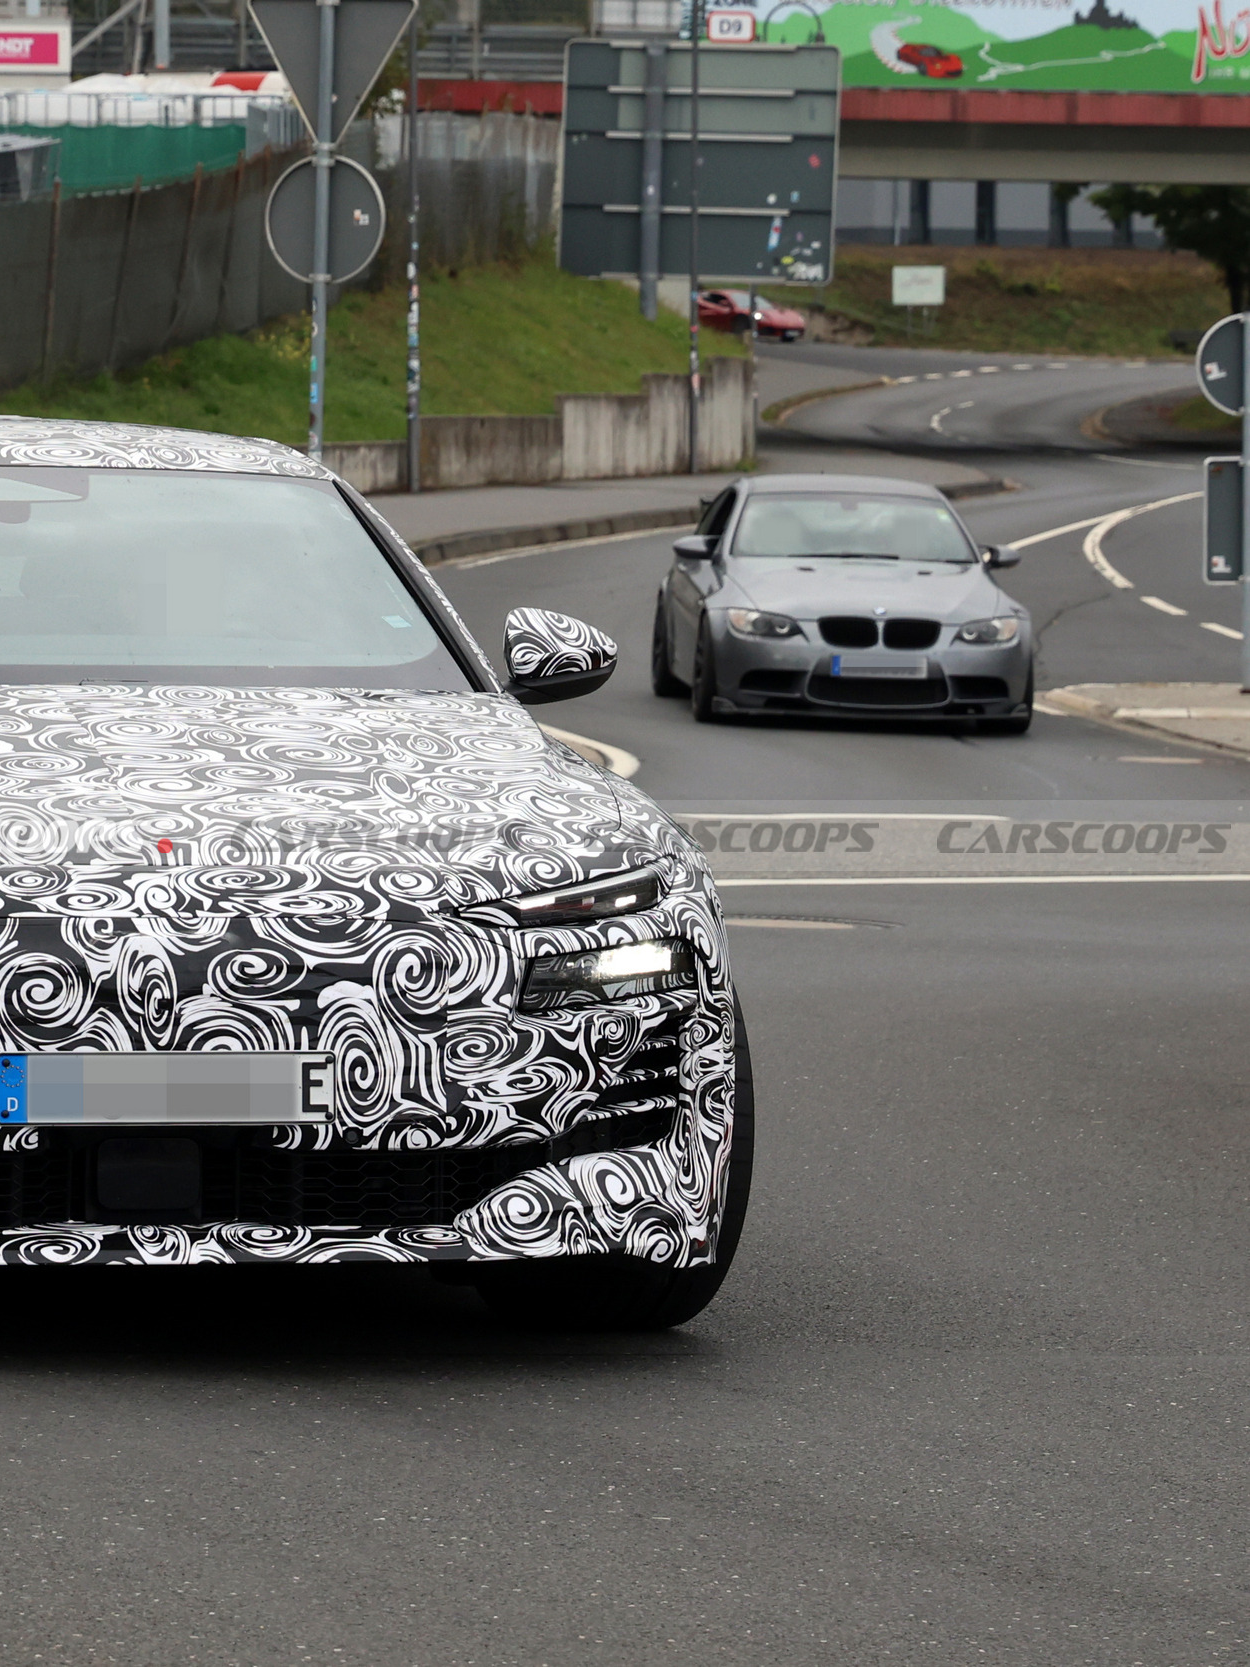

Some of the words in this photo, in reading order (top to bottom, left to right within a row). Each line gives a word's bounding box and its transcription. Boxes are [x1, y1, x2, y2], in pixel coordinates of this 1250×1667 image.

[719, 19, 742, 34] D9
[302, 1062, 330, 1113] E
[6, 1097, 18, 1112] D
